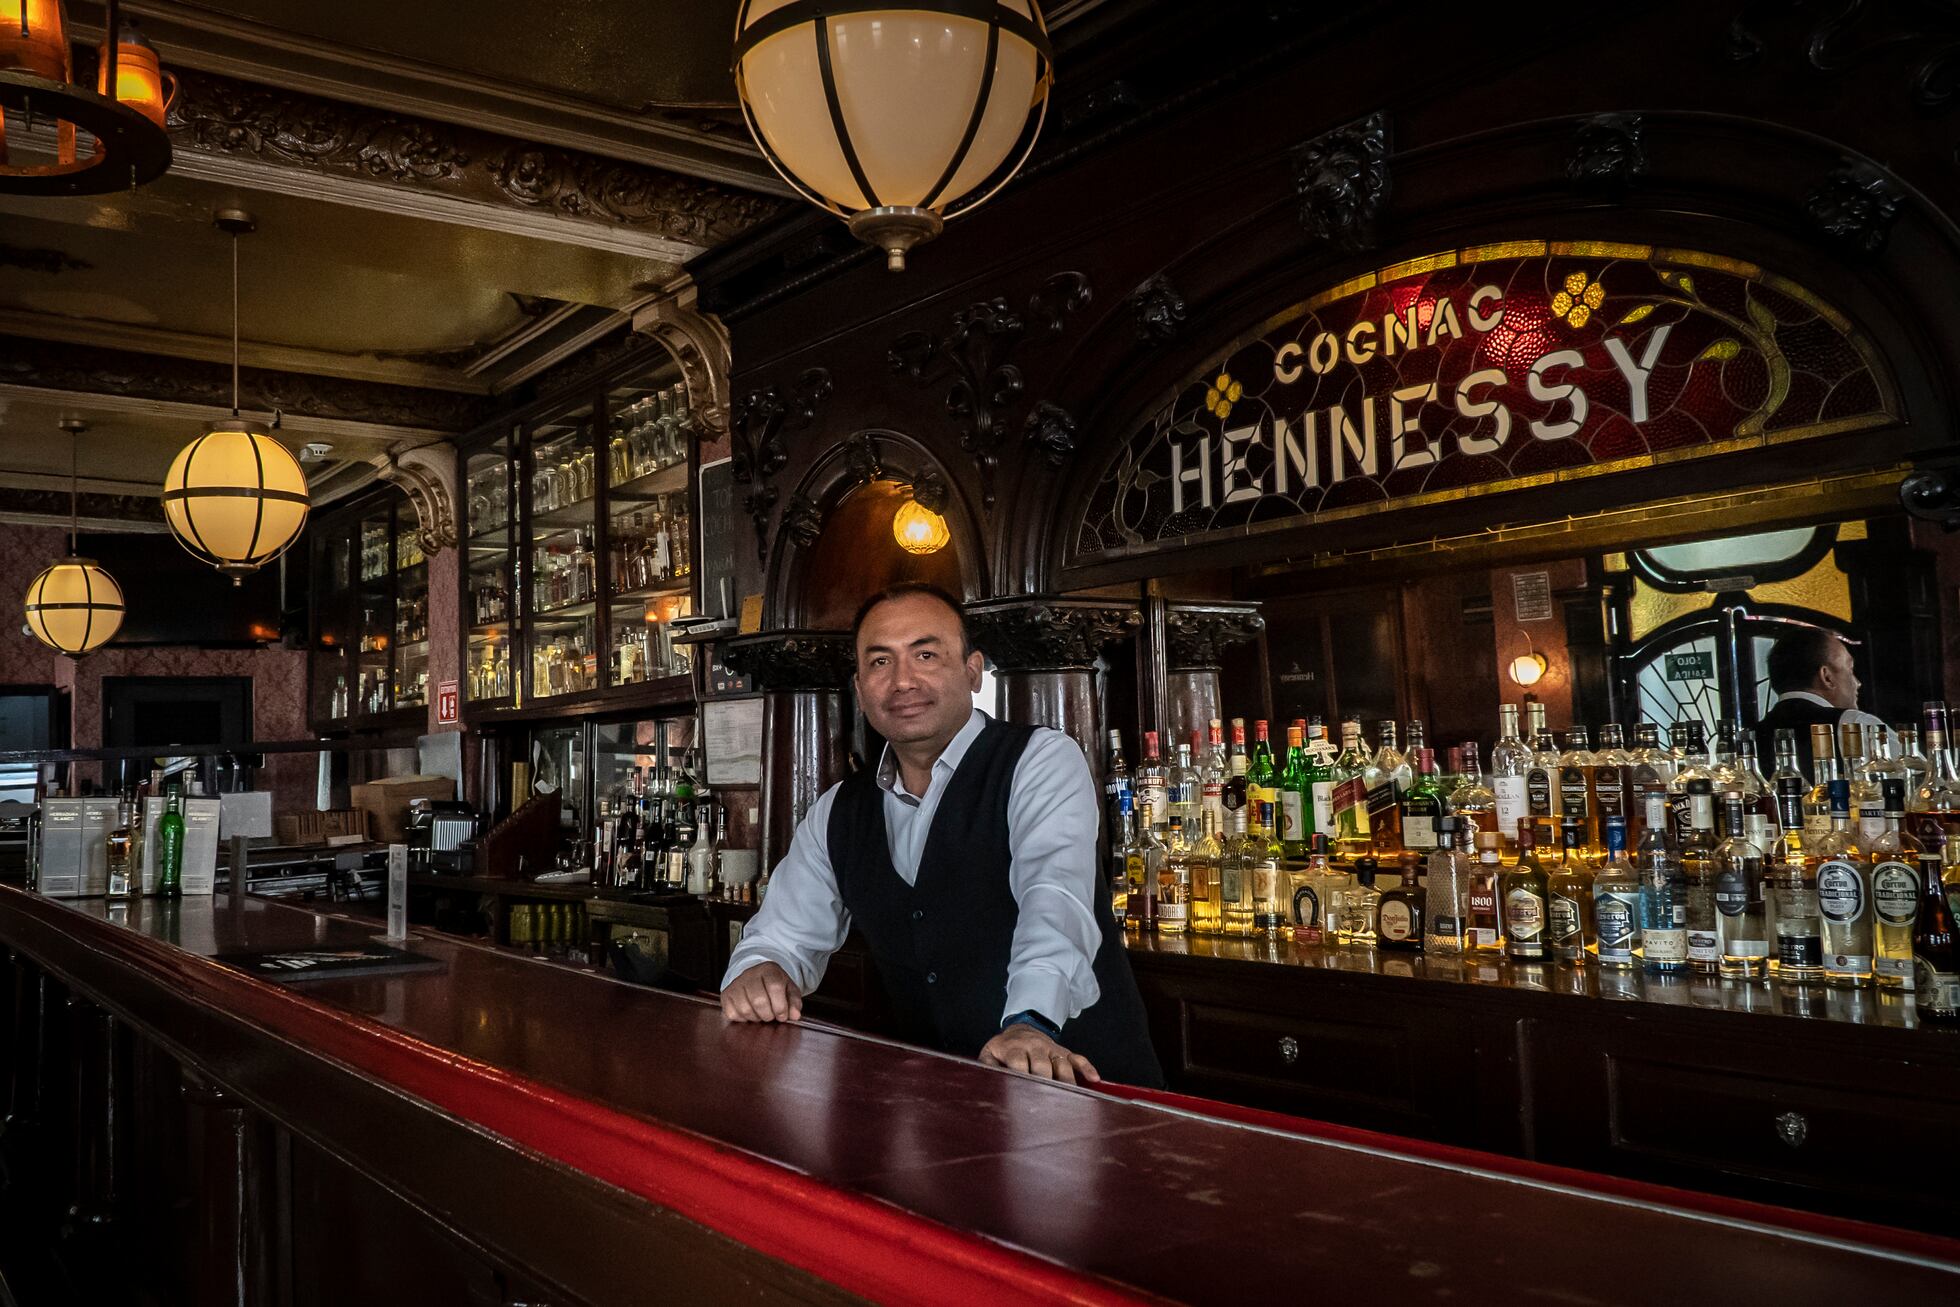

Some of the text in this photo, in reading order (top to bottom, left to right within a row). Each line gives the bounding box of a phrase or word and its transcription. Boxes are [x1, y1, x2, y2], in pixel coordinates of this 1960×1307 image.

[1274, 285, 1504, 384] COGNAC
[1172, 325, 1672, 513] HENNESSY
[1471, 896, 1492, 907] 1800
[1599, 912, 1626, 920] eserva
